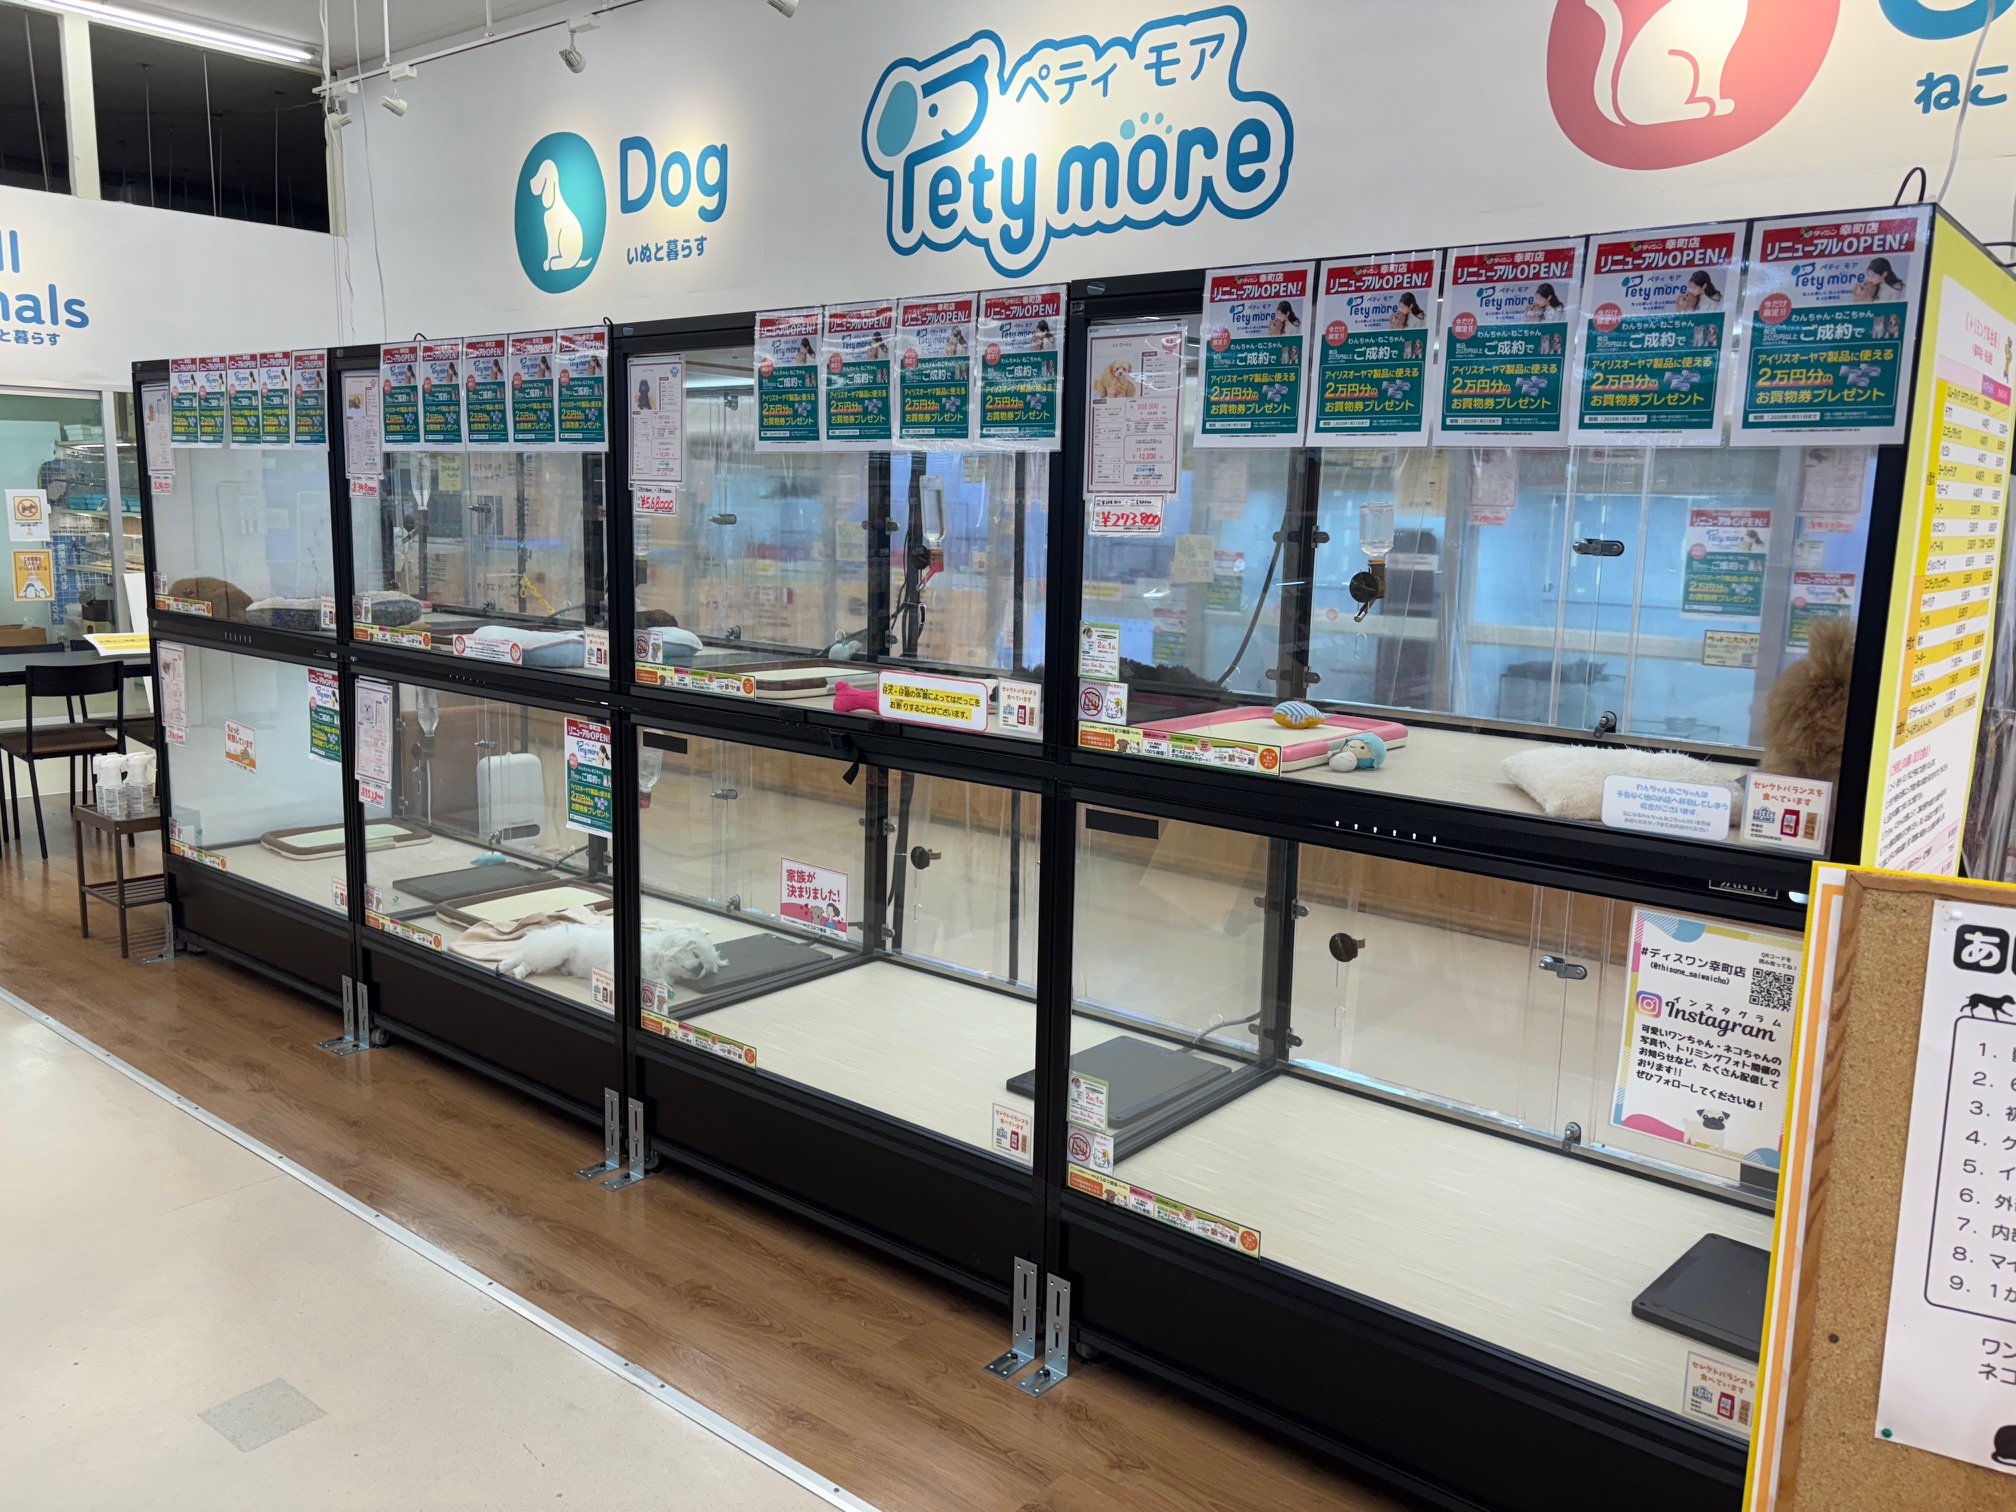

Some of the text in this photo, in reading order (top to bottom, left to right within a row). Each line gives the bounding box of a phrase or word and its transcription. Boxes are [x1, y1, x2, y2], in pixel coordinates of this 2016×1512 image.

[1016, 33, 1225, 105] ペティ モア
[1914, 65, 2009, 114] ねこ
[1057, 118, 1271, 214] more
[620, 136, 728, 223] Dog
[1839, 222, 1879, 236] 幸町店
[627, 236, 707, 265] いぬと暮らす
[1665, 237, 1700, 250] 幸町店
[1767, 233, 1909, 260] リニューアルOPEN!
[1514, 251, 1545, 263] 幸町店
[1601, 248, 1727, 271] リニューアルOPEN!
[1380, 263, 1407, 274] 幸町店
[1458, 261, 1568, 282] リニューアルOPEN!
[1260, 272, 1284, 283] 幸町店
[1330, 272, 1428, 292] リニューアルOPEN!
[1828, 273, 1865, 285] more
[1215, 281, 1303, 300] リニューアルOPEN!
[1654, 285, 1688, 295] more
[1506, 295, 1535, 305] more
[1373, 304, 1398, 314] more
[1253, 312, 1276, 321] more
[1800, 324, 1865, 340] ご成約で
[1485, 340, 1535, 354] ご成約で
[1630, 333, 1687, 348] ご成約で
[1237, 352, 1277, 364] ご成約で
[1354, 346, 1399, 359] ご成約で
[1758, 349, 1894, 365] アイリスオーヤマ製品に使える
[1453, 363, 1558, 375] アイリスオーヤマ製品に使える
[1592, 357, 1712, 370] アイリスオーヤマ製品に使える
[1211, 372, 1295, 383] アイリスオーヤマ製品に使える
[1325, 367, 1419, 379] アイリスオーヤマ製品に使える
[1758, 367, 1833, 385] 2万円分の
[1453, 378, 1511, 392] 2万円分の
[1592, 373, 1659, 389] 2万円分の
[1211, 386, 1258, 399] 2万円分の
[1325, 382, 1378, 396] 2万円分の
[1756, 388, 1885, 404] お買物券プレゼント
[1325, 400, 1414, 412] お買物券プレゼント
[1452, 397, 1552, 409] お買物券プレゼント
[1591, 393, 1704, 406] お買物券プレゼント
[1210, 403, 1291, 414] お買物券プレゼント
[1753, 781, 1824, 797] セレクトバランスを
[1762, 792, 1811, 806] 食べています
[786, 869, 816, 884] 家族が
[787, 884, 840, 902] 決まりました!
[1961, 932, 2001, 967] あ
[1640, 947, 1746, 978] #ディスワン幸町店
[1665, 1001, 1776, 1043] Instagram
[1641, 1024, 1782, 1065] 可愛いワンちゃん・ネコちゃんの
[1639, 1047, 1779, 1089] お知らせなど、たくさん配信して
